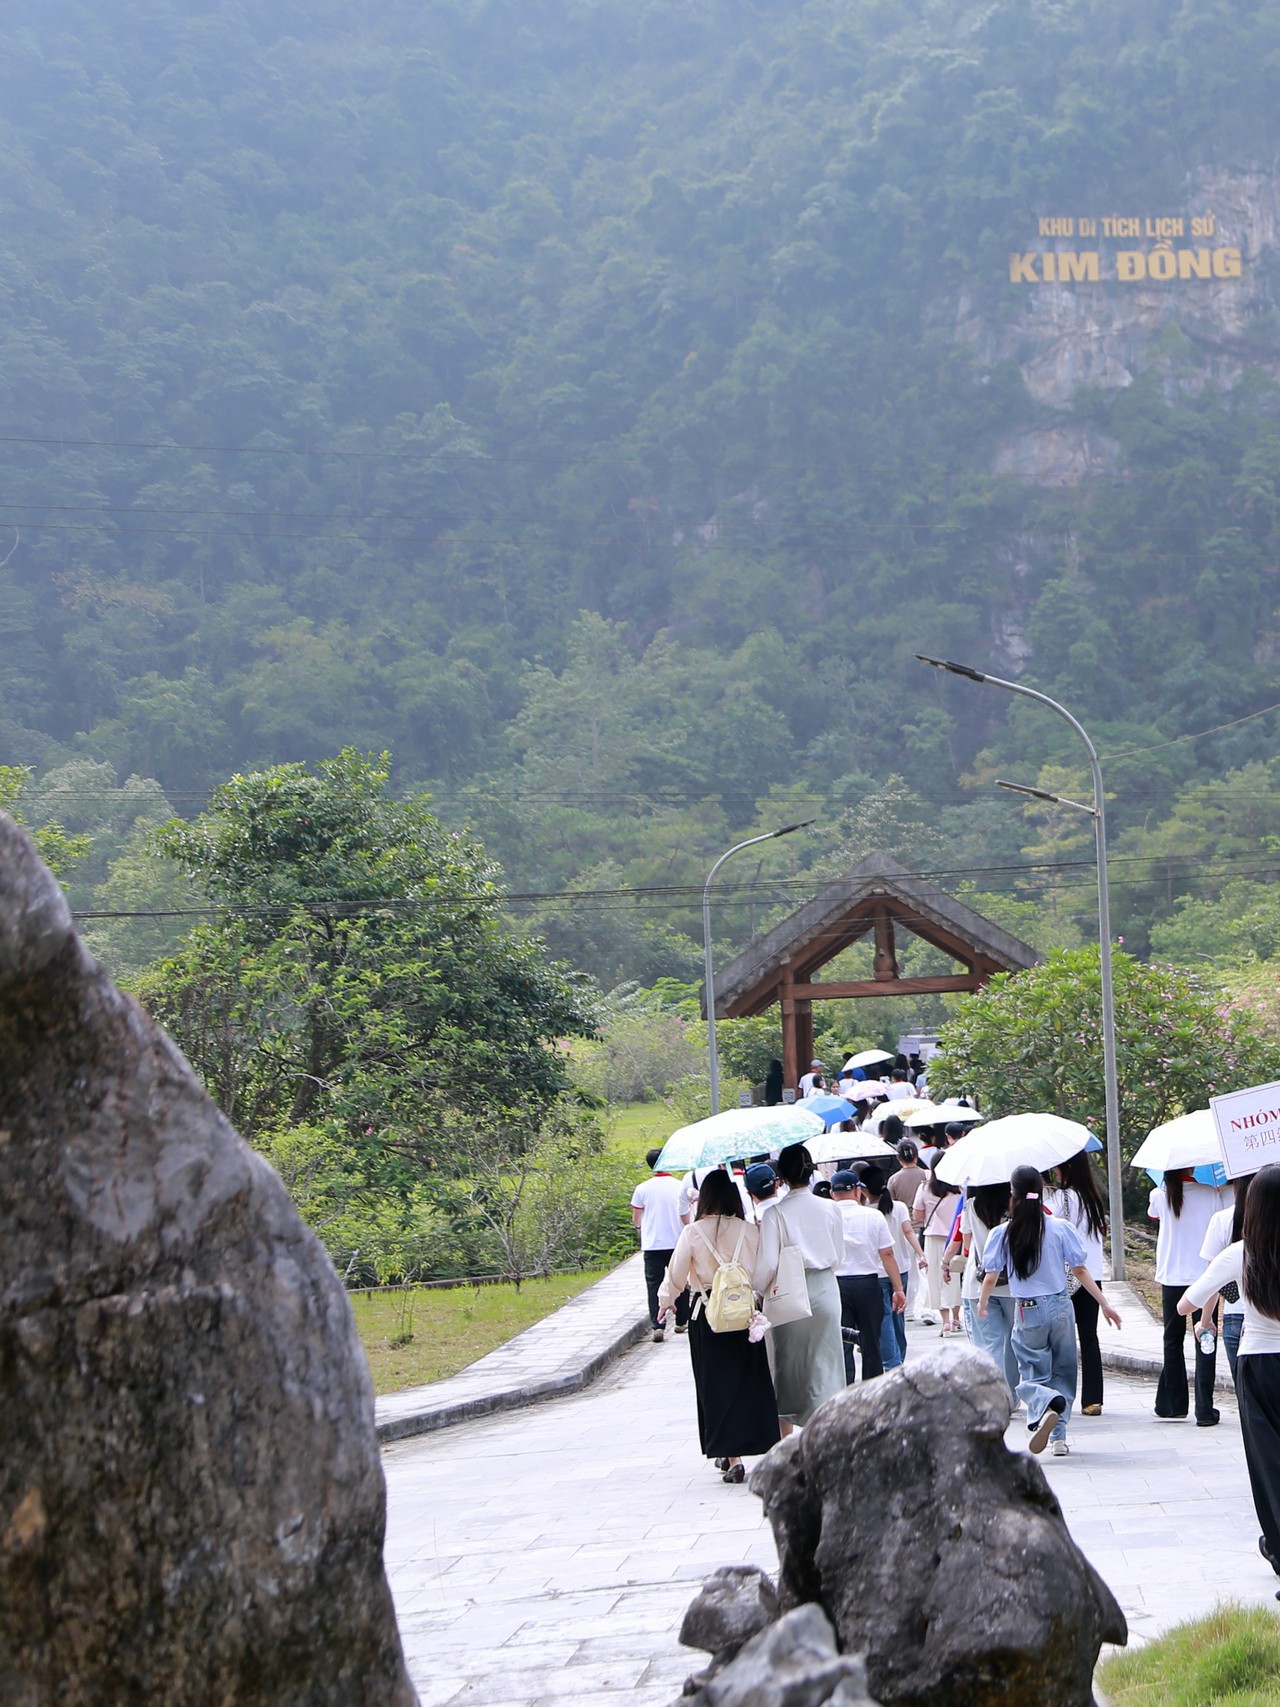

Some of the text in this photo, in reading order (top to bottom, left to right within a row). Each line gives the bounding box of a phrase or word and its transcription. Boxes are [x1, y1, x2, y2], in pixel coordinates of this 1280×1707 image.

[1038, 207, 1216, 241] KHU DI TÍCH LỊCH SỬ
[1009, 239, 1242, 283] KIM ĐỒNG
